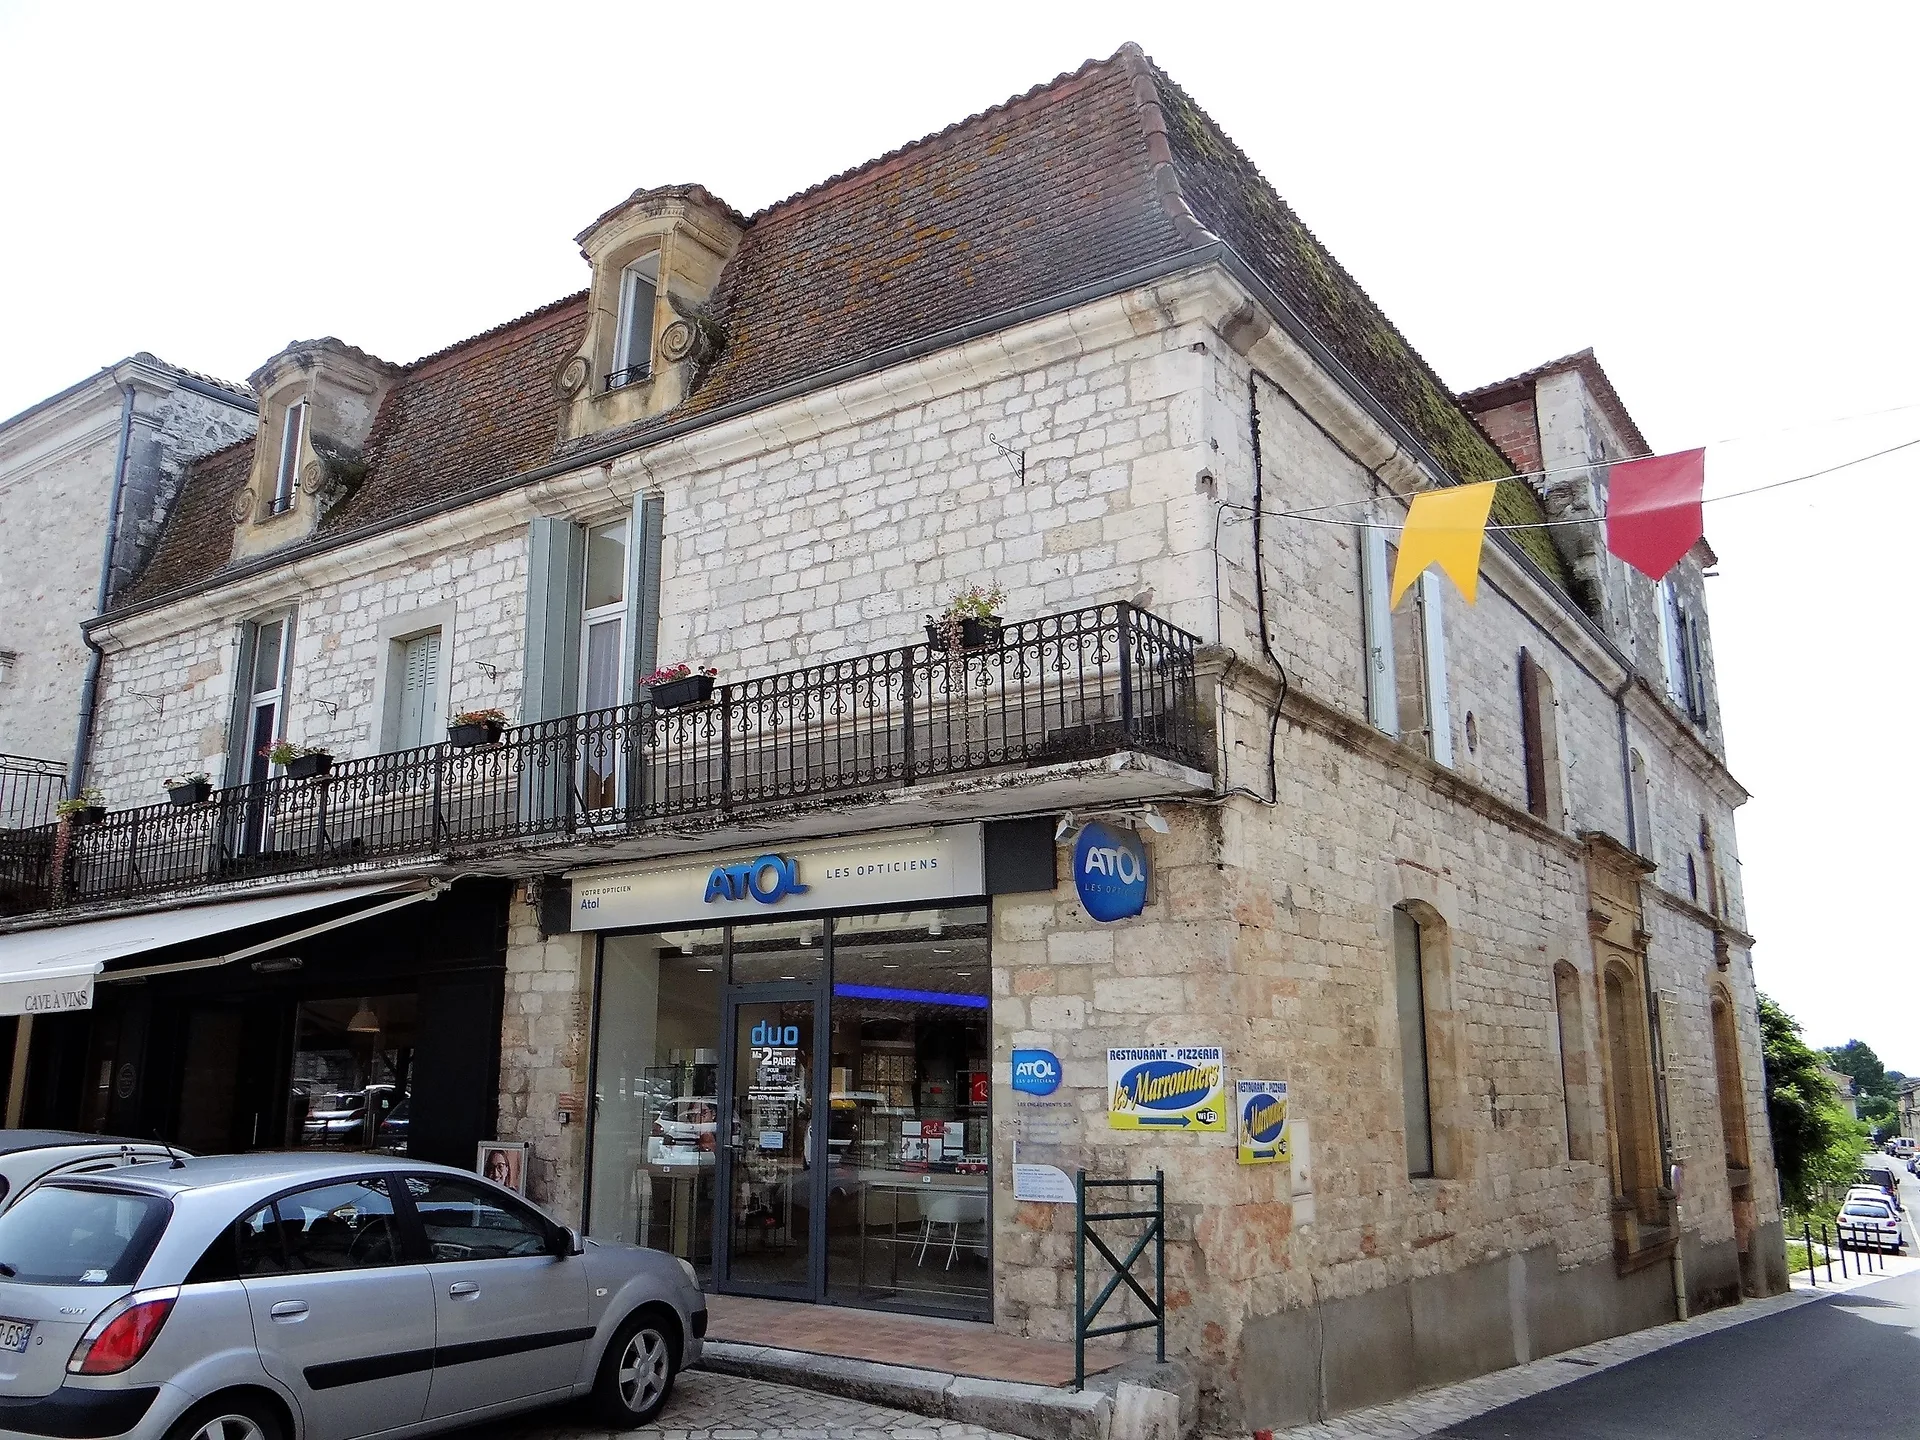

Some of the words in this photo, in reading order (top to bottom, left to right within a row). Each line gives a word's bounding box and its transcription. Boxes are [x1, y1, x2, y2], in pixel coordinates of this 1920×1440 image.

[826, 867, 850, 879] LES
[857, 858, 938, 876] OPTICIENS
[1085, 846, 1145, 885] ATOL
[703, 853, 810, 904] ATOL
[1085, 884, 1102, 892] LES
[580, 888, 601, 897] VOTRE
[602, 885, 632, 895] OPTICIEN
[580, 897, 600, 910] Atol
[25, 994, 52, 1011] CAVE
[53, 989, 61, 1009] À
[62, 990, 88, 1008] VINS
[751, 1019, 799, 1046] duo
[772, 1056, 797, 1066] PAIRE
[1110, 1048, 1168, 1061] RESTAURANT
[1177, 1048, 1219, 1060] PIZZERIA
[1016, 1060, 1056, 1078] ATOL
[1131, 1062, 1220, 1111] Marronniers
